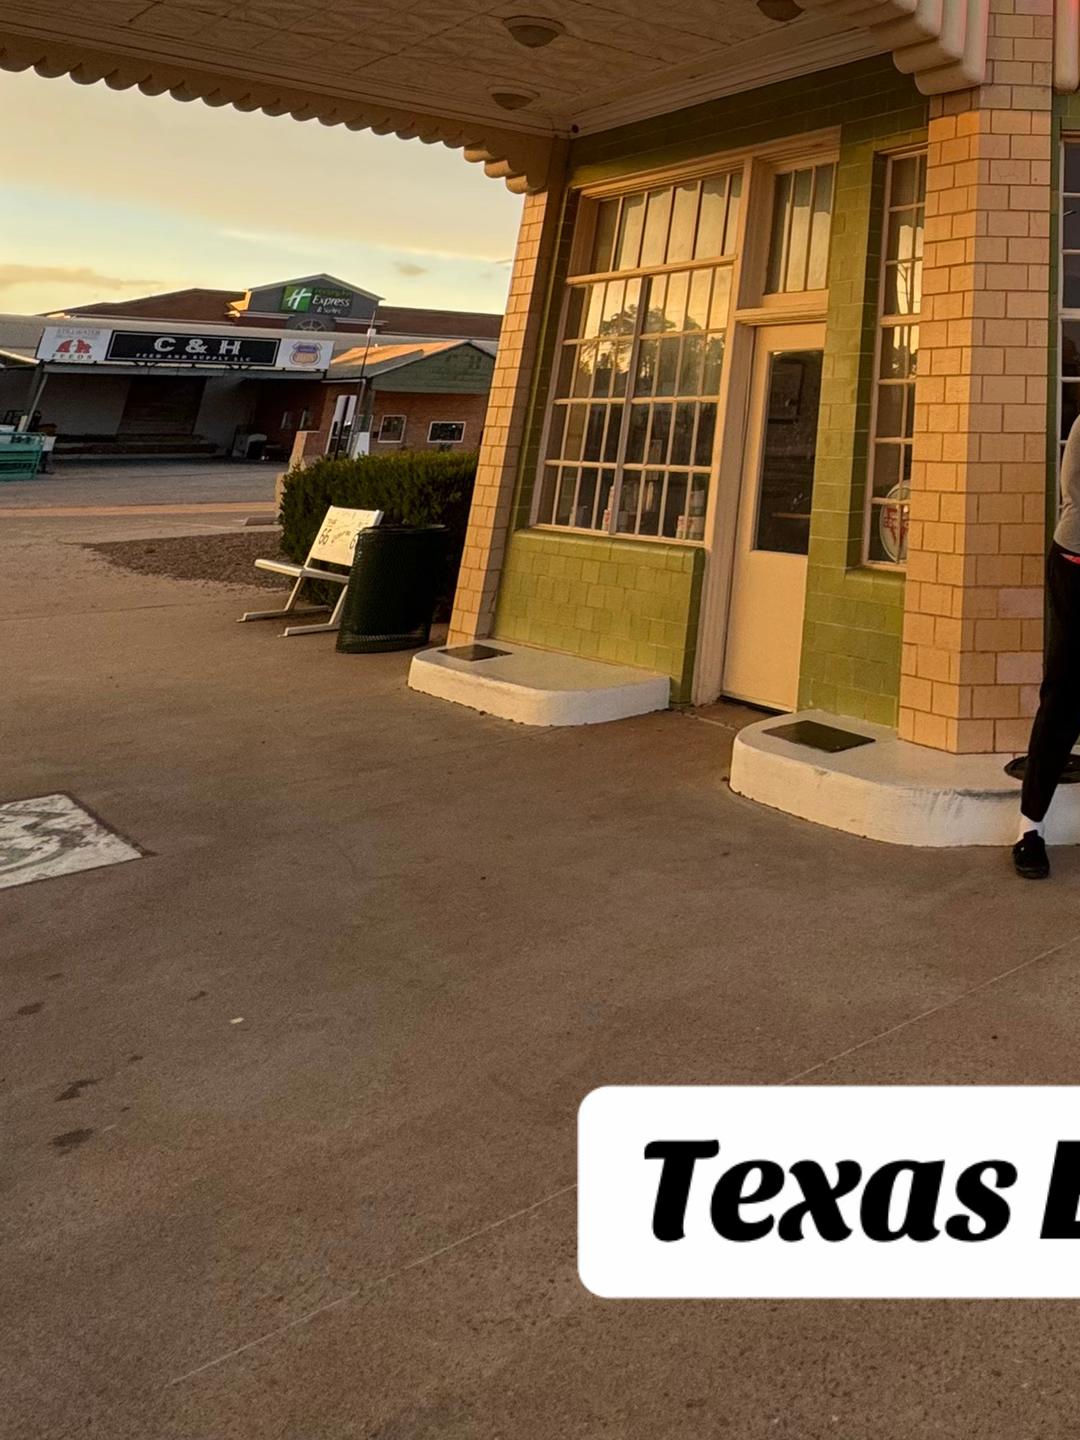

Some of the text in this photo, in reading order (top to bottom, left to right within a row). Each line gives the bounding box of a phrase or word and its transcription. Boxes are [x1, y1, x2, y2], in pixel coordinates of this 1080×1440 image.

[312, 294, 350, 308] Express
[154, 337, 242, 355] C & H
